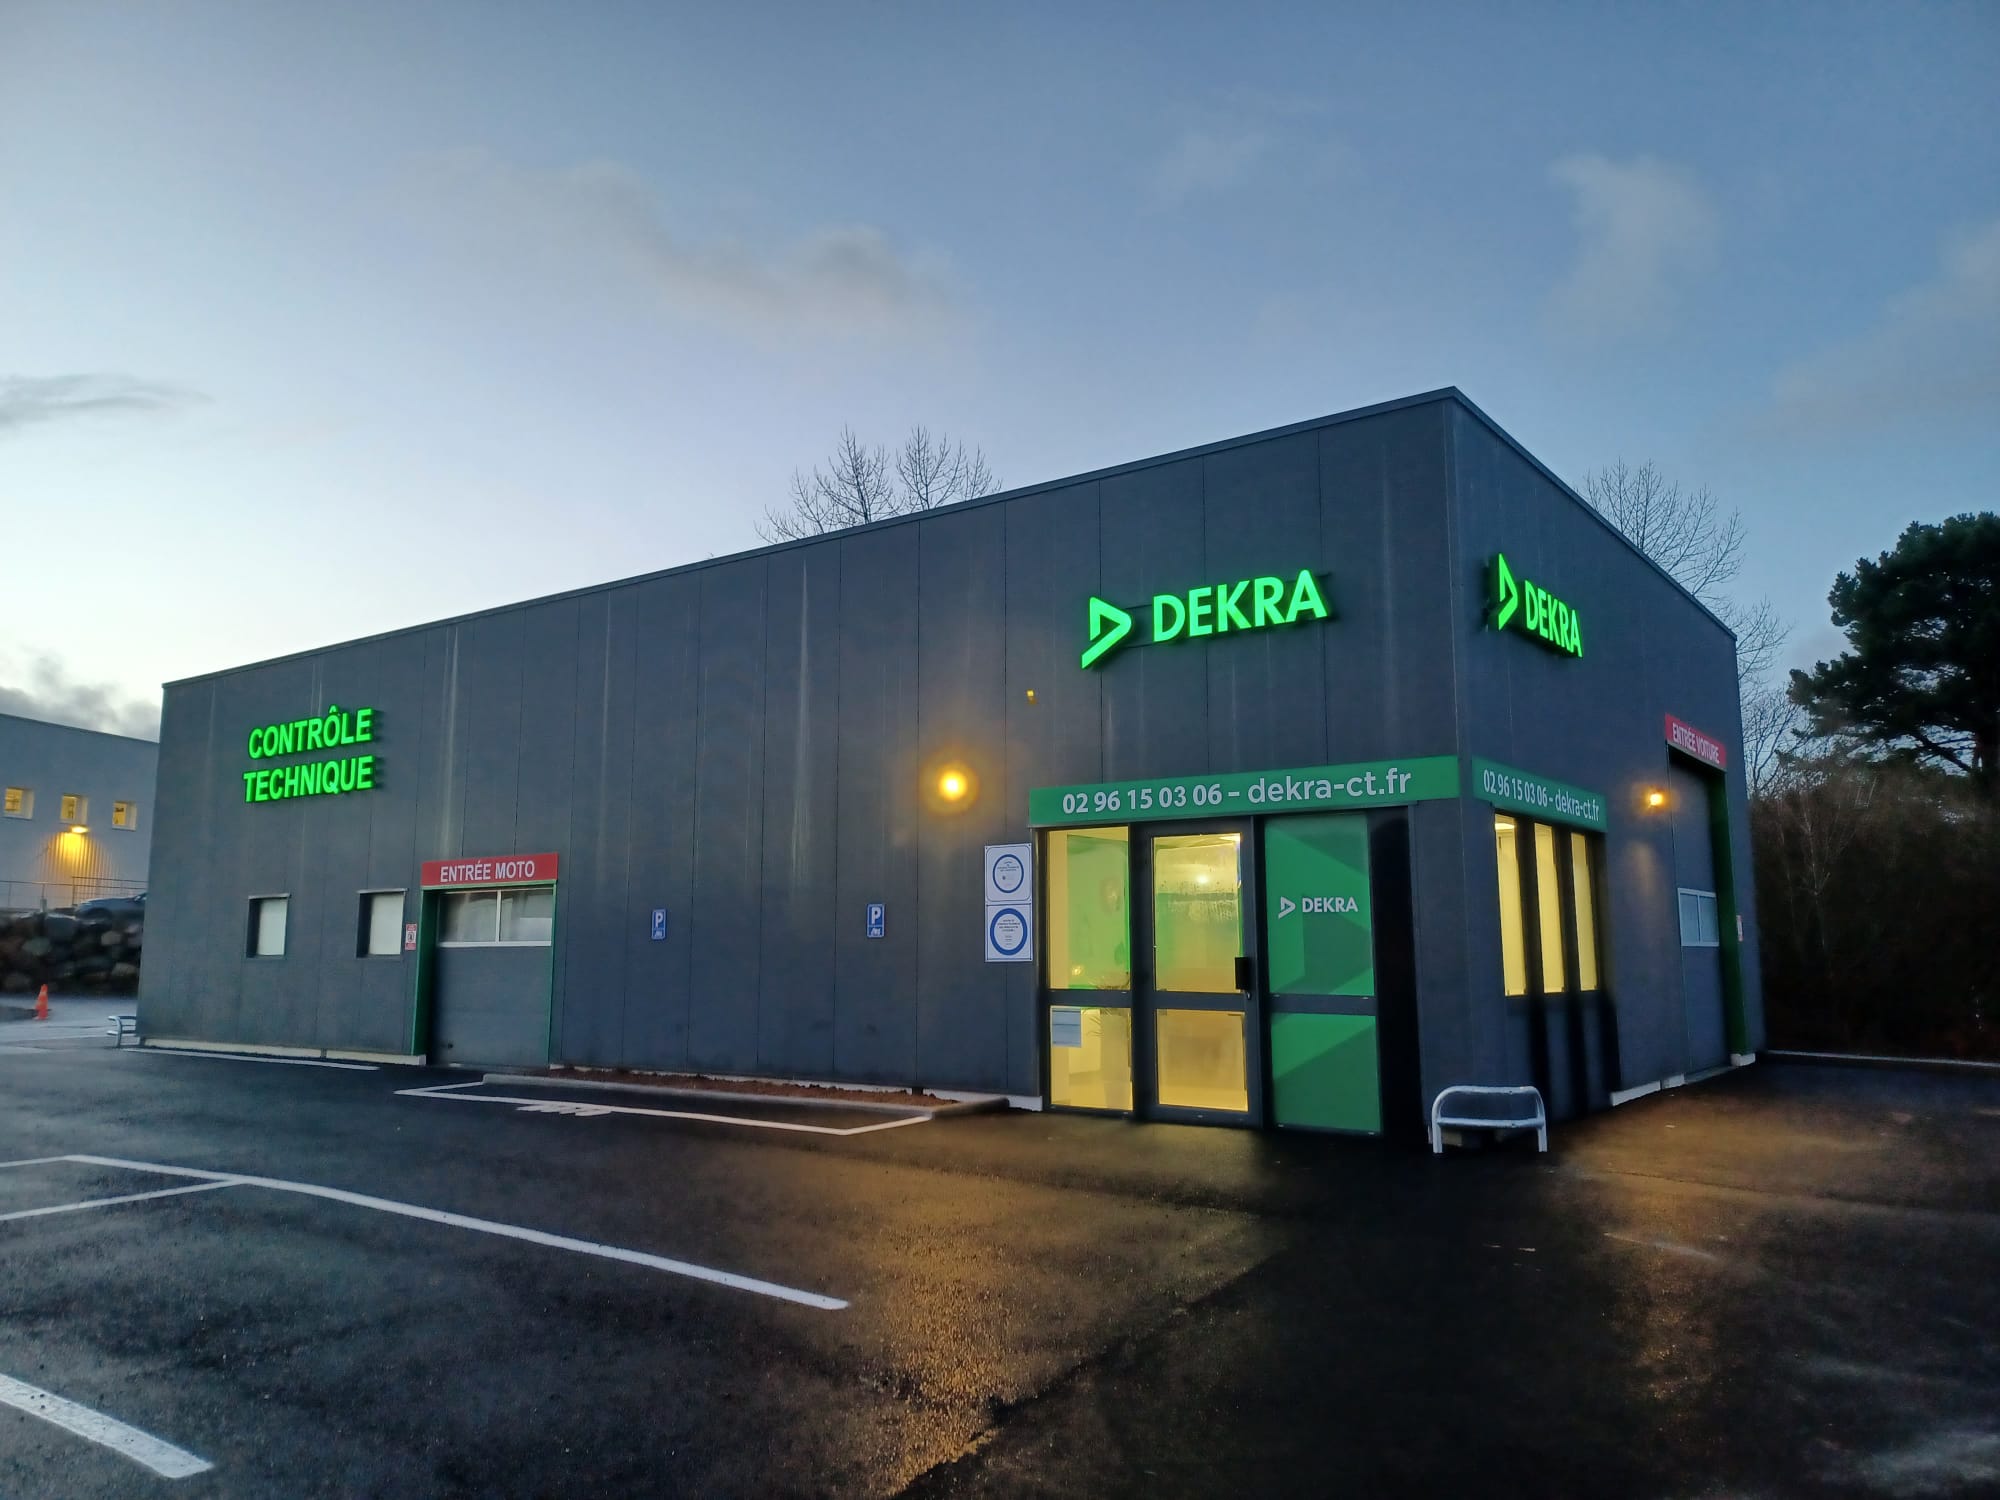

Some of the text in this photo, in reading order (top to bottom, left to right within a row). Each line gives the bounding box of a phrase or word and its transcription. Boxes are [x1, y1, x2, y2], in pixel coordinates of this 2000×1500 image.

[1153, 569, 1328, 643] DEKRA
[1525, 580, 1583, 658] DEKRA
[248, 704, 373, 759] CONTRÔLE
[1672, 721, 1697, 753] ENTRÉE
[243, 755, 374, 802] TECHNIQUE
[1062, 793, 1089, 814] 02
[1094, 790, 1121, 813] 96
[1127, 788, 1153, 810] 15
[1158, 785, 1187, 808] 03
[1192, 783, 1223, 806] 06
[1247, 767, 1412, 804] dekra-ct.fr
[1483, 769, 1497, 794] 02
[1498, 773, 1510, 797] 96
[1511, 777, 1523, 801] 15
[1524, 781, 1536, 804] 03
[1536, 785, 1548, 807] 06
[1555, 789, 1600, 822] dekra-ct.fr
[440, 860, 535, 883] ENTRÉE MOTO
[655, 911, 664, 928] P
[871, 906, 881, 925] P
[1302, 896, 1358, 913] DEKRA
